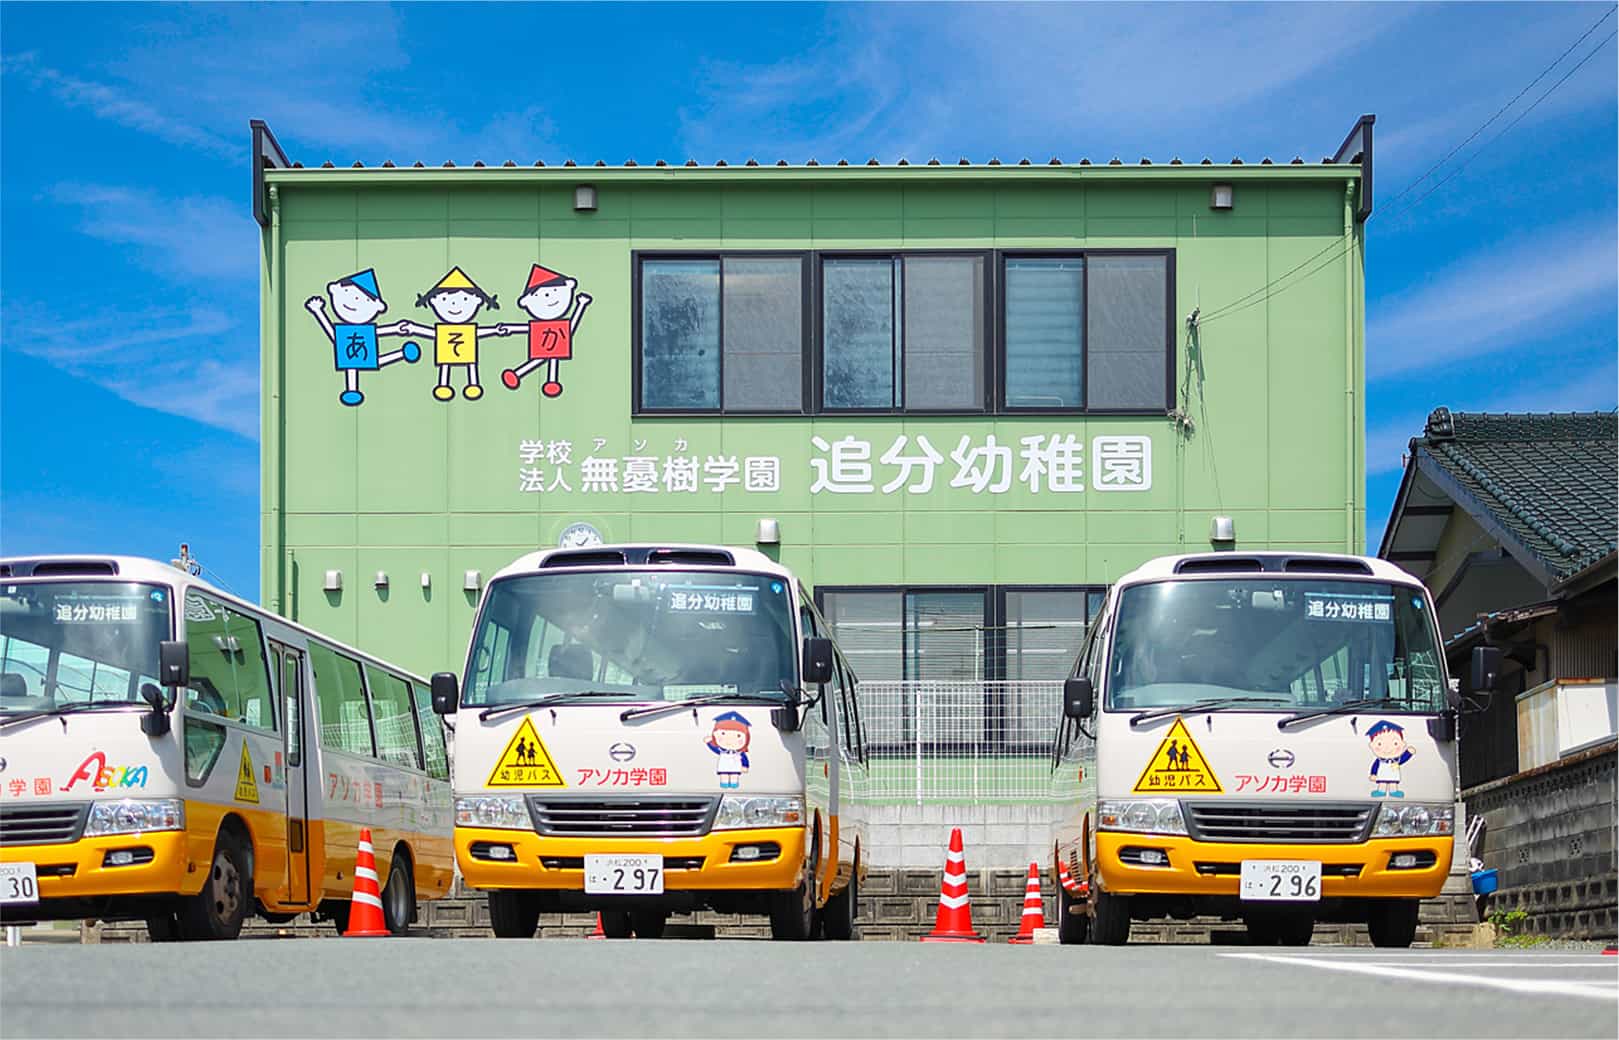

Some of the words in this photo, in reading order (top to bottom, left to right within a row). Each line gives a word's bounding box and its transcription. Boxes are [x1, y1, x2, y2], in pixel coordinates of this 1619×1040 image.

[346, 332, 368, 361] あ
[447, 332, 465, 357] そ
[540, 327, 566, 352] か
[519, 439, 572, 465] 学校
[810, 433, 1153, 494] 追分幼稚園
[519, 467, 572, 493] 法人
[670, 592, 753, 611] 追分幼稚園
[1308, 600, 1390, 620] 追分幼稚園
[56, 603, 137, 621] 追分幼稚園
[500, 771, 551, 781] 幼児バス
[577, 768, 667, 786] アソカ学園
[1148, 774, 1206, 787] 幼児バス
[1235, 775, 1327, 793] アソカ学園
[0, 777, 51, 797] 学園
